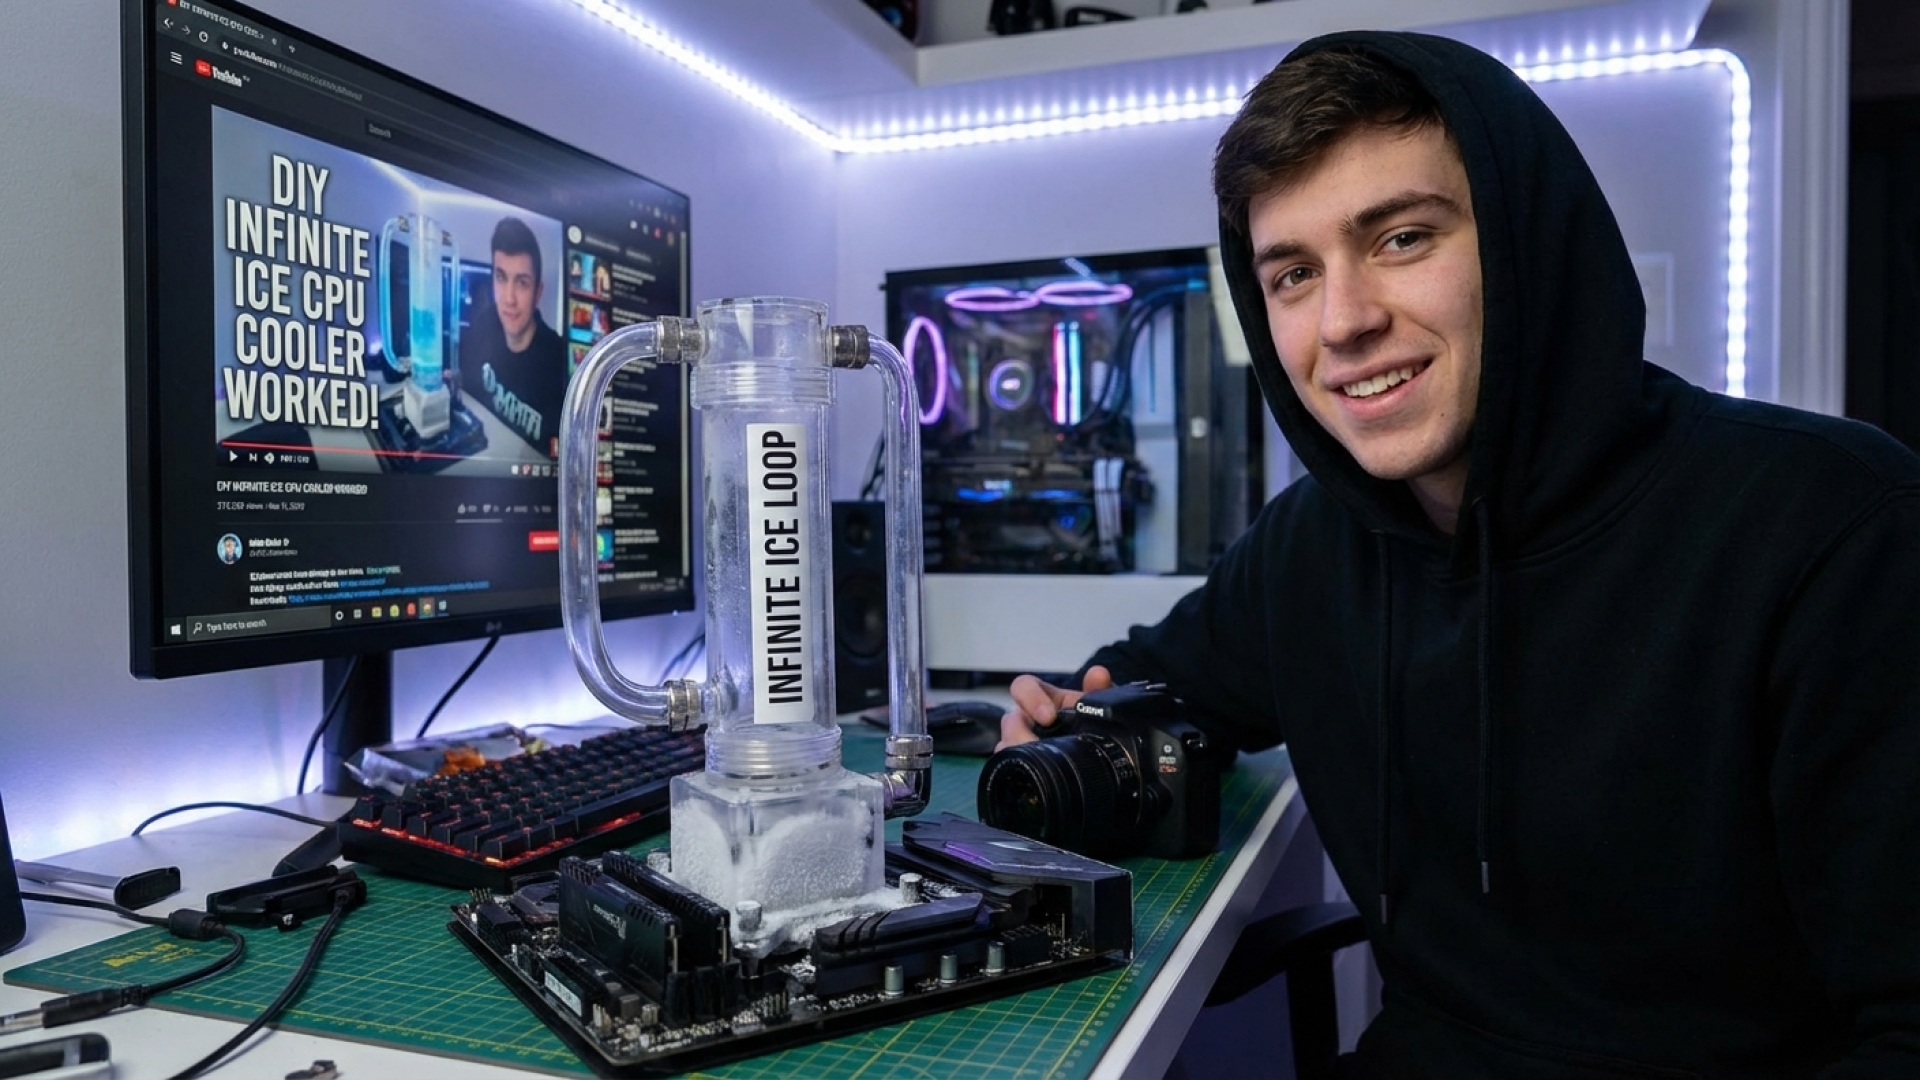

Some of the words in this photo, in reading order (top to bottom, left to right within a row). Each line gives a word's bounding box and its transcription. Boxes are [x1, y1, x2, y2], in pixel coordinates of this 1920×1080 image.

[272, 154, 330, 216] DIY
[226, 197, 371, 278] INFINITE
[234, 256, 292, 316] ICE
[302, 270, 365, 327] CPU
[235, 313, 366, 378] COOLER
[223, 367, 380, 430] WORKED!
[761, 430, 798, 508] LOOP
[764, 518, 800, 566] ICE
[765, 575, 803, 704] INFINITE
